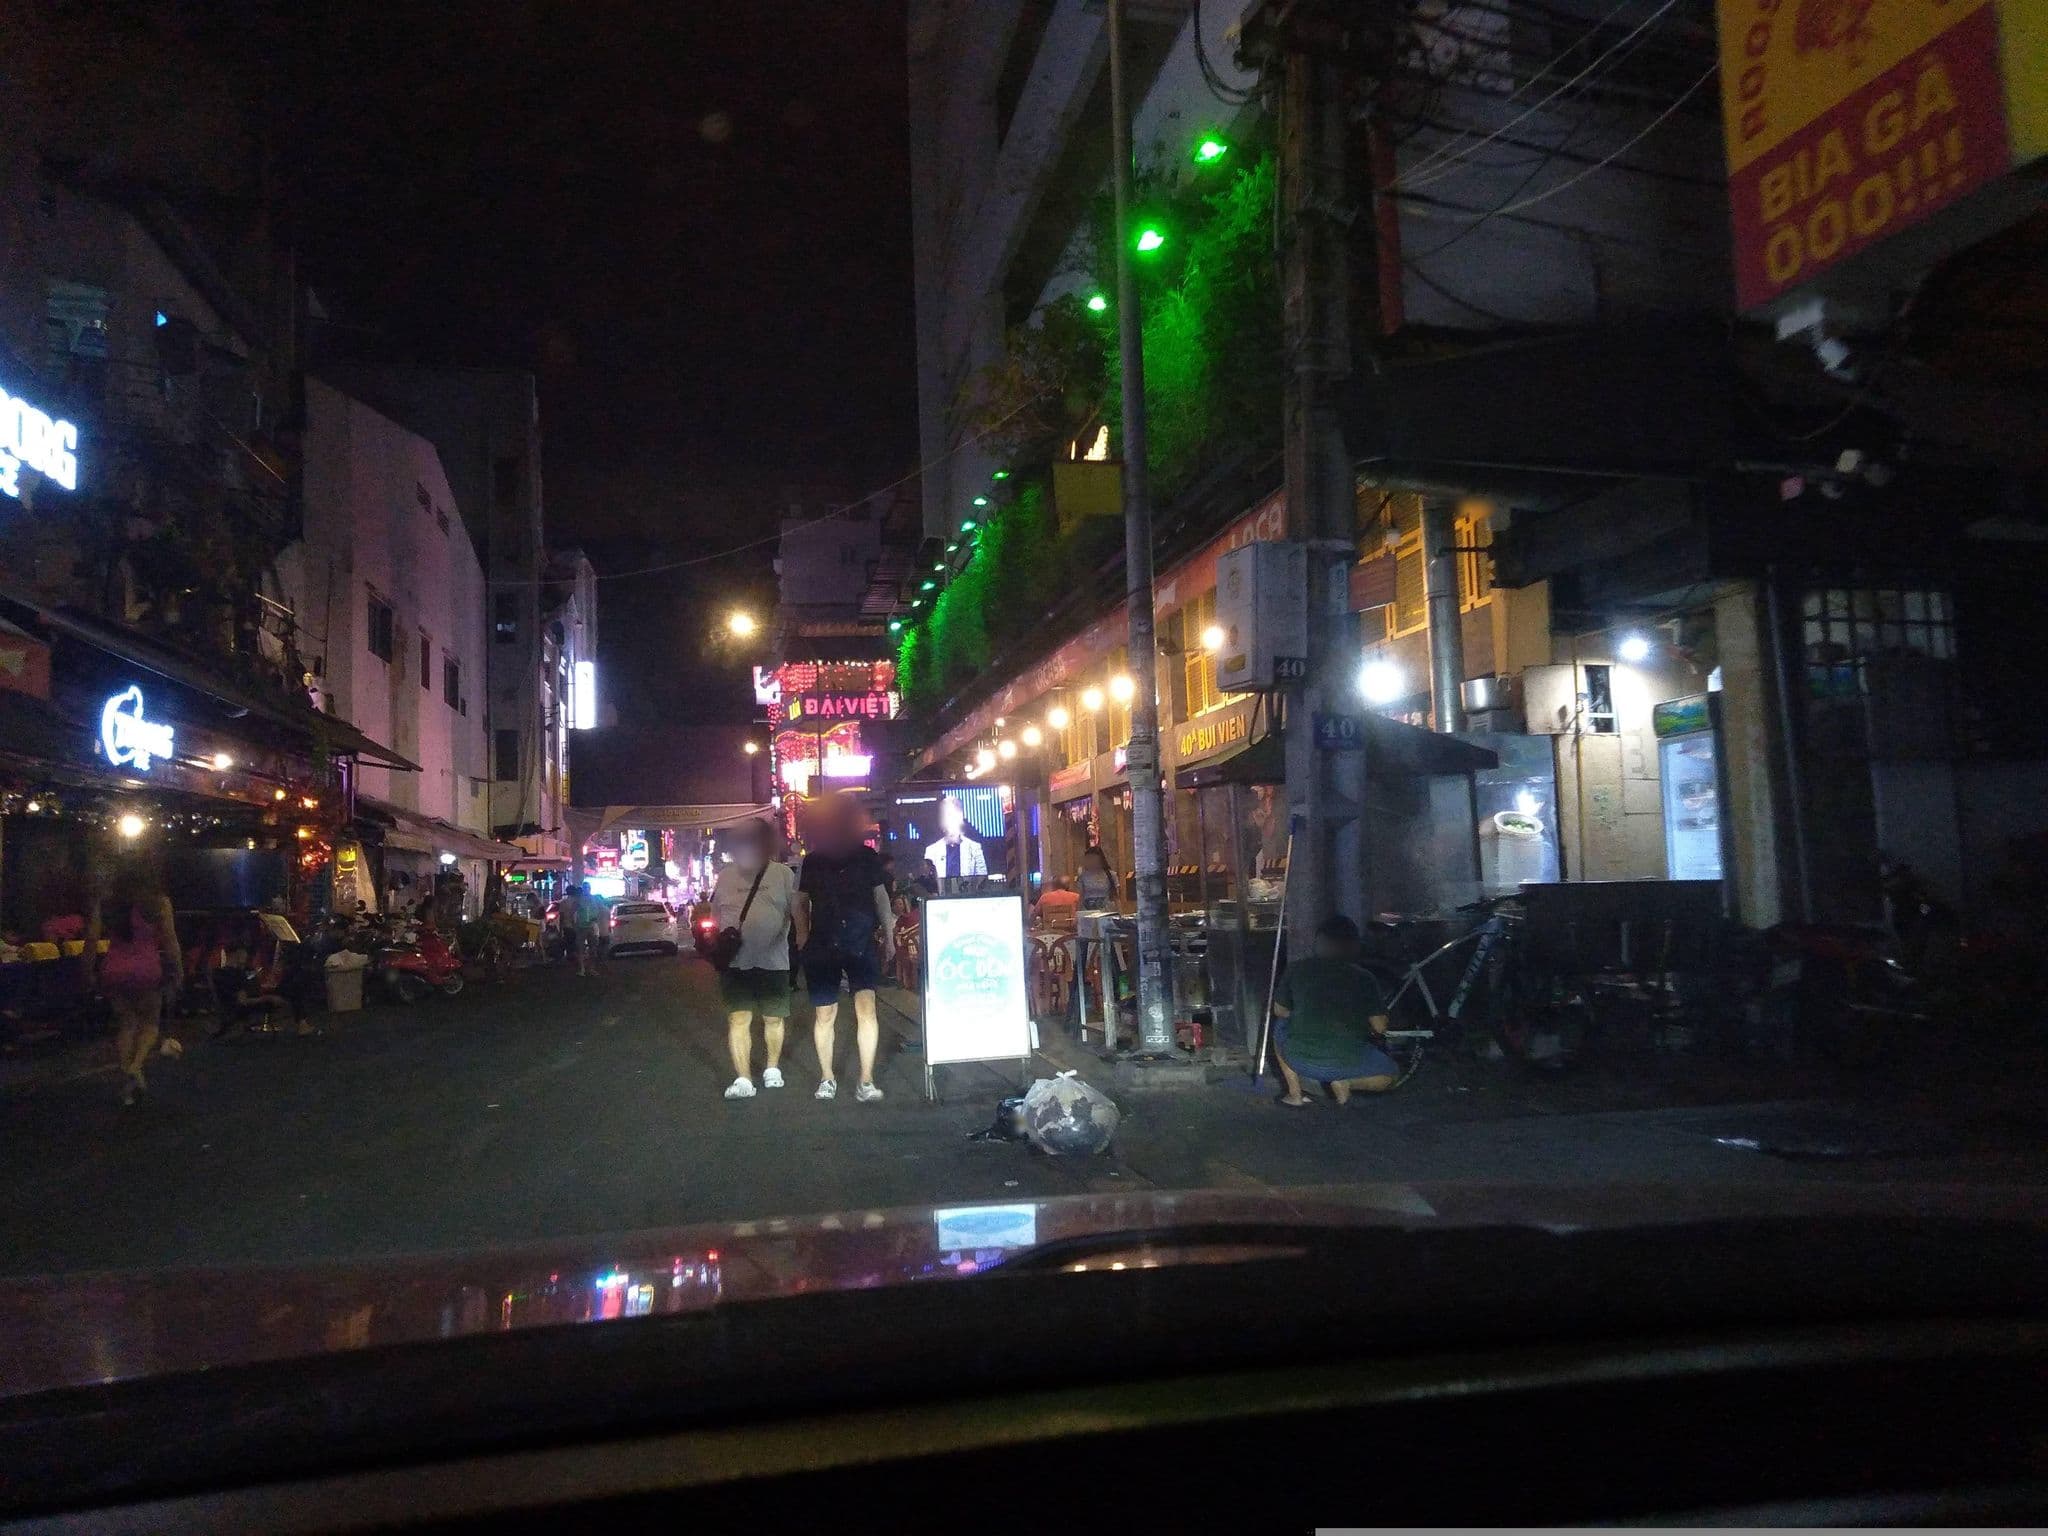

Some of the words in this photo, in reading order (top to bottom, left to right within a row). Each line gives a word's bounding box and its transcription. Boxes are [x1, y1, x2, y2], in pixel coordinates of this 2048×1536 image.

[1759, 127, 1856, 222] BIA
[1276, 658, 1306, 678] 40
[1198, 725, 1217, 751] BUI
[1218, 714, 1246, 744] VIEN
[1321, 716, 1355, 738] 40
